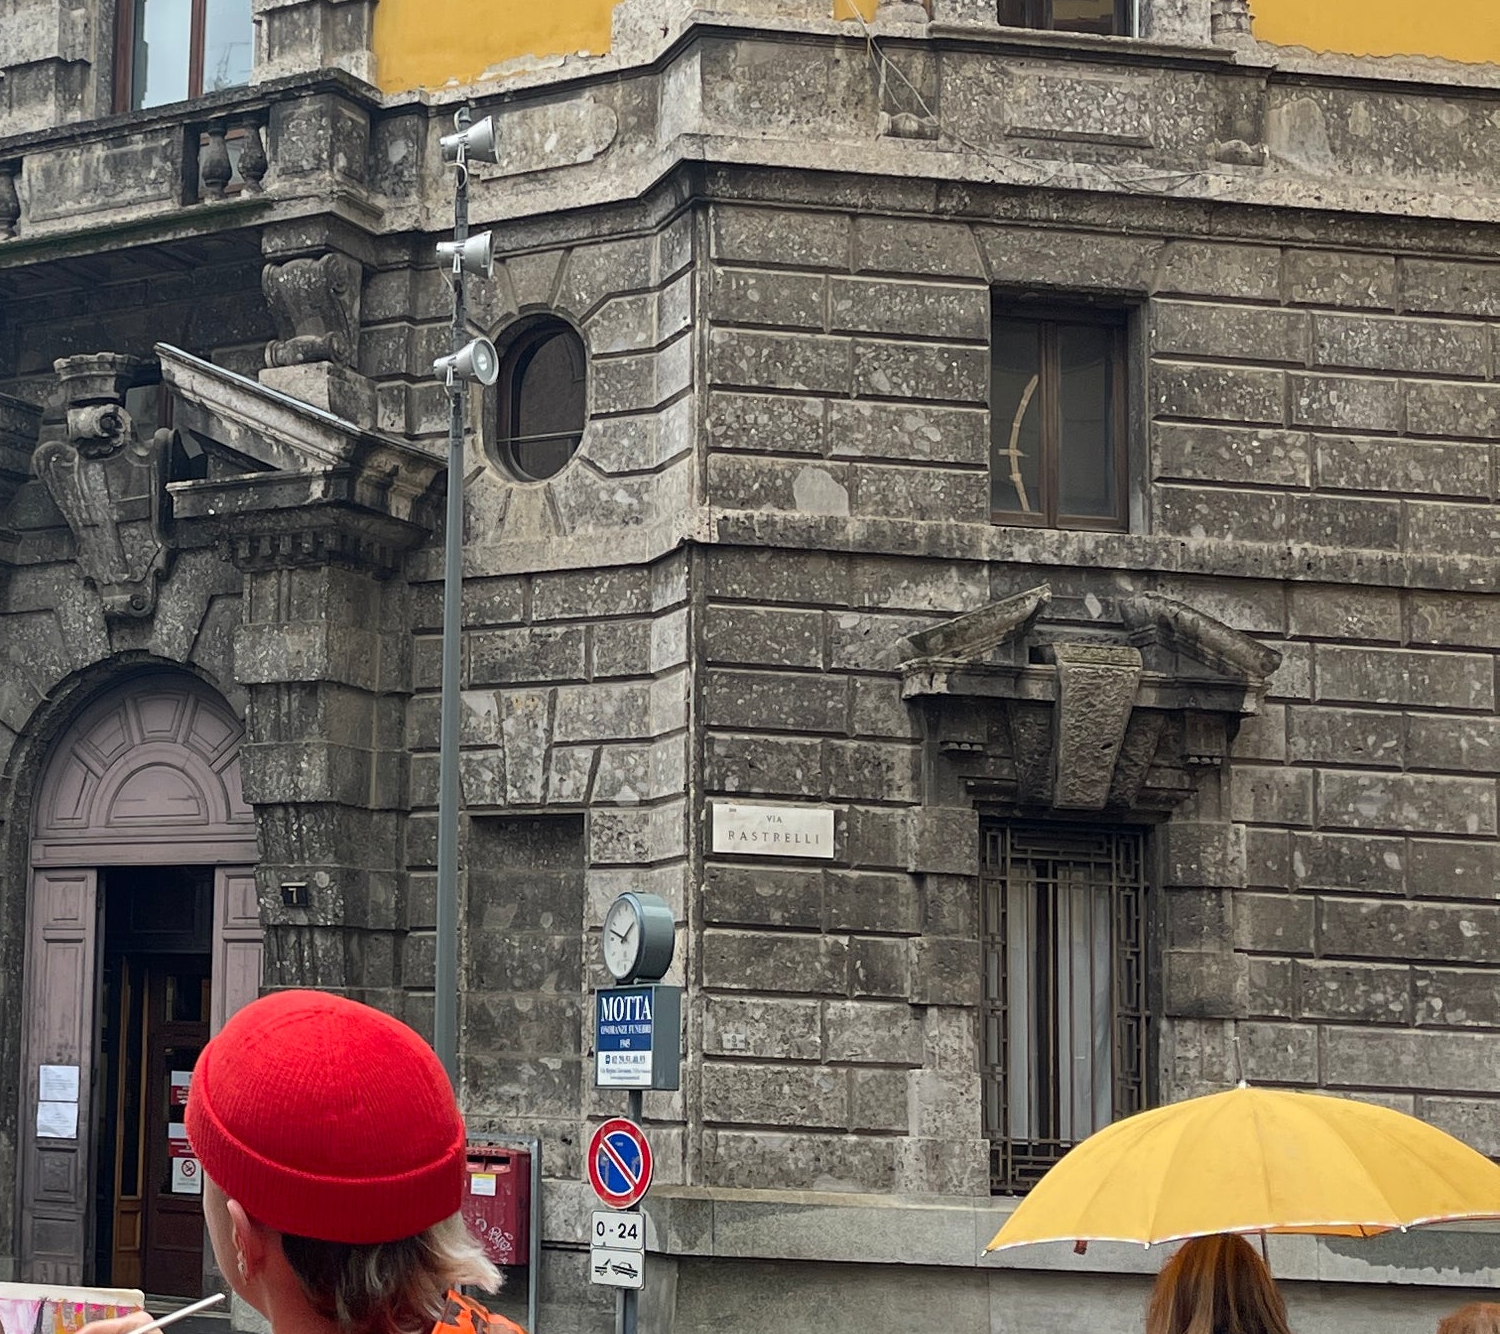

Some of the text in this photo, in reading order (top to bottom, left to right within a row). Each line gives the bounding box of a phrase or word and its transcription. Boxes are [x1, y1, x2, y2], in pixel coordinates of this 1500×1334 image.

[766, 815, 783, 824] VIA
[728, 830, 820, 845] RASTRELLI
[288, 887, 298, 904] 7
[600, 995, 652, 1022] MOTTA
